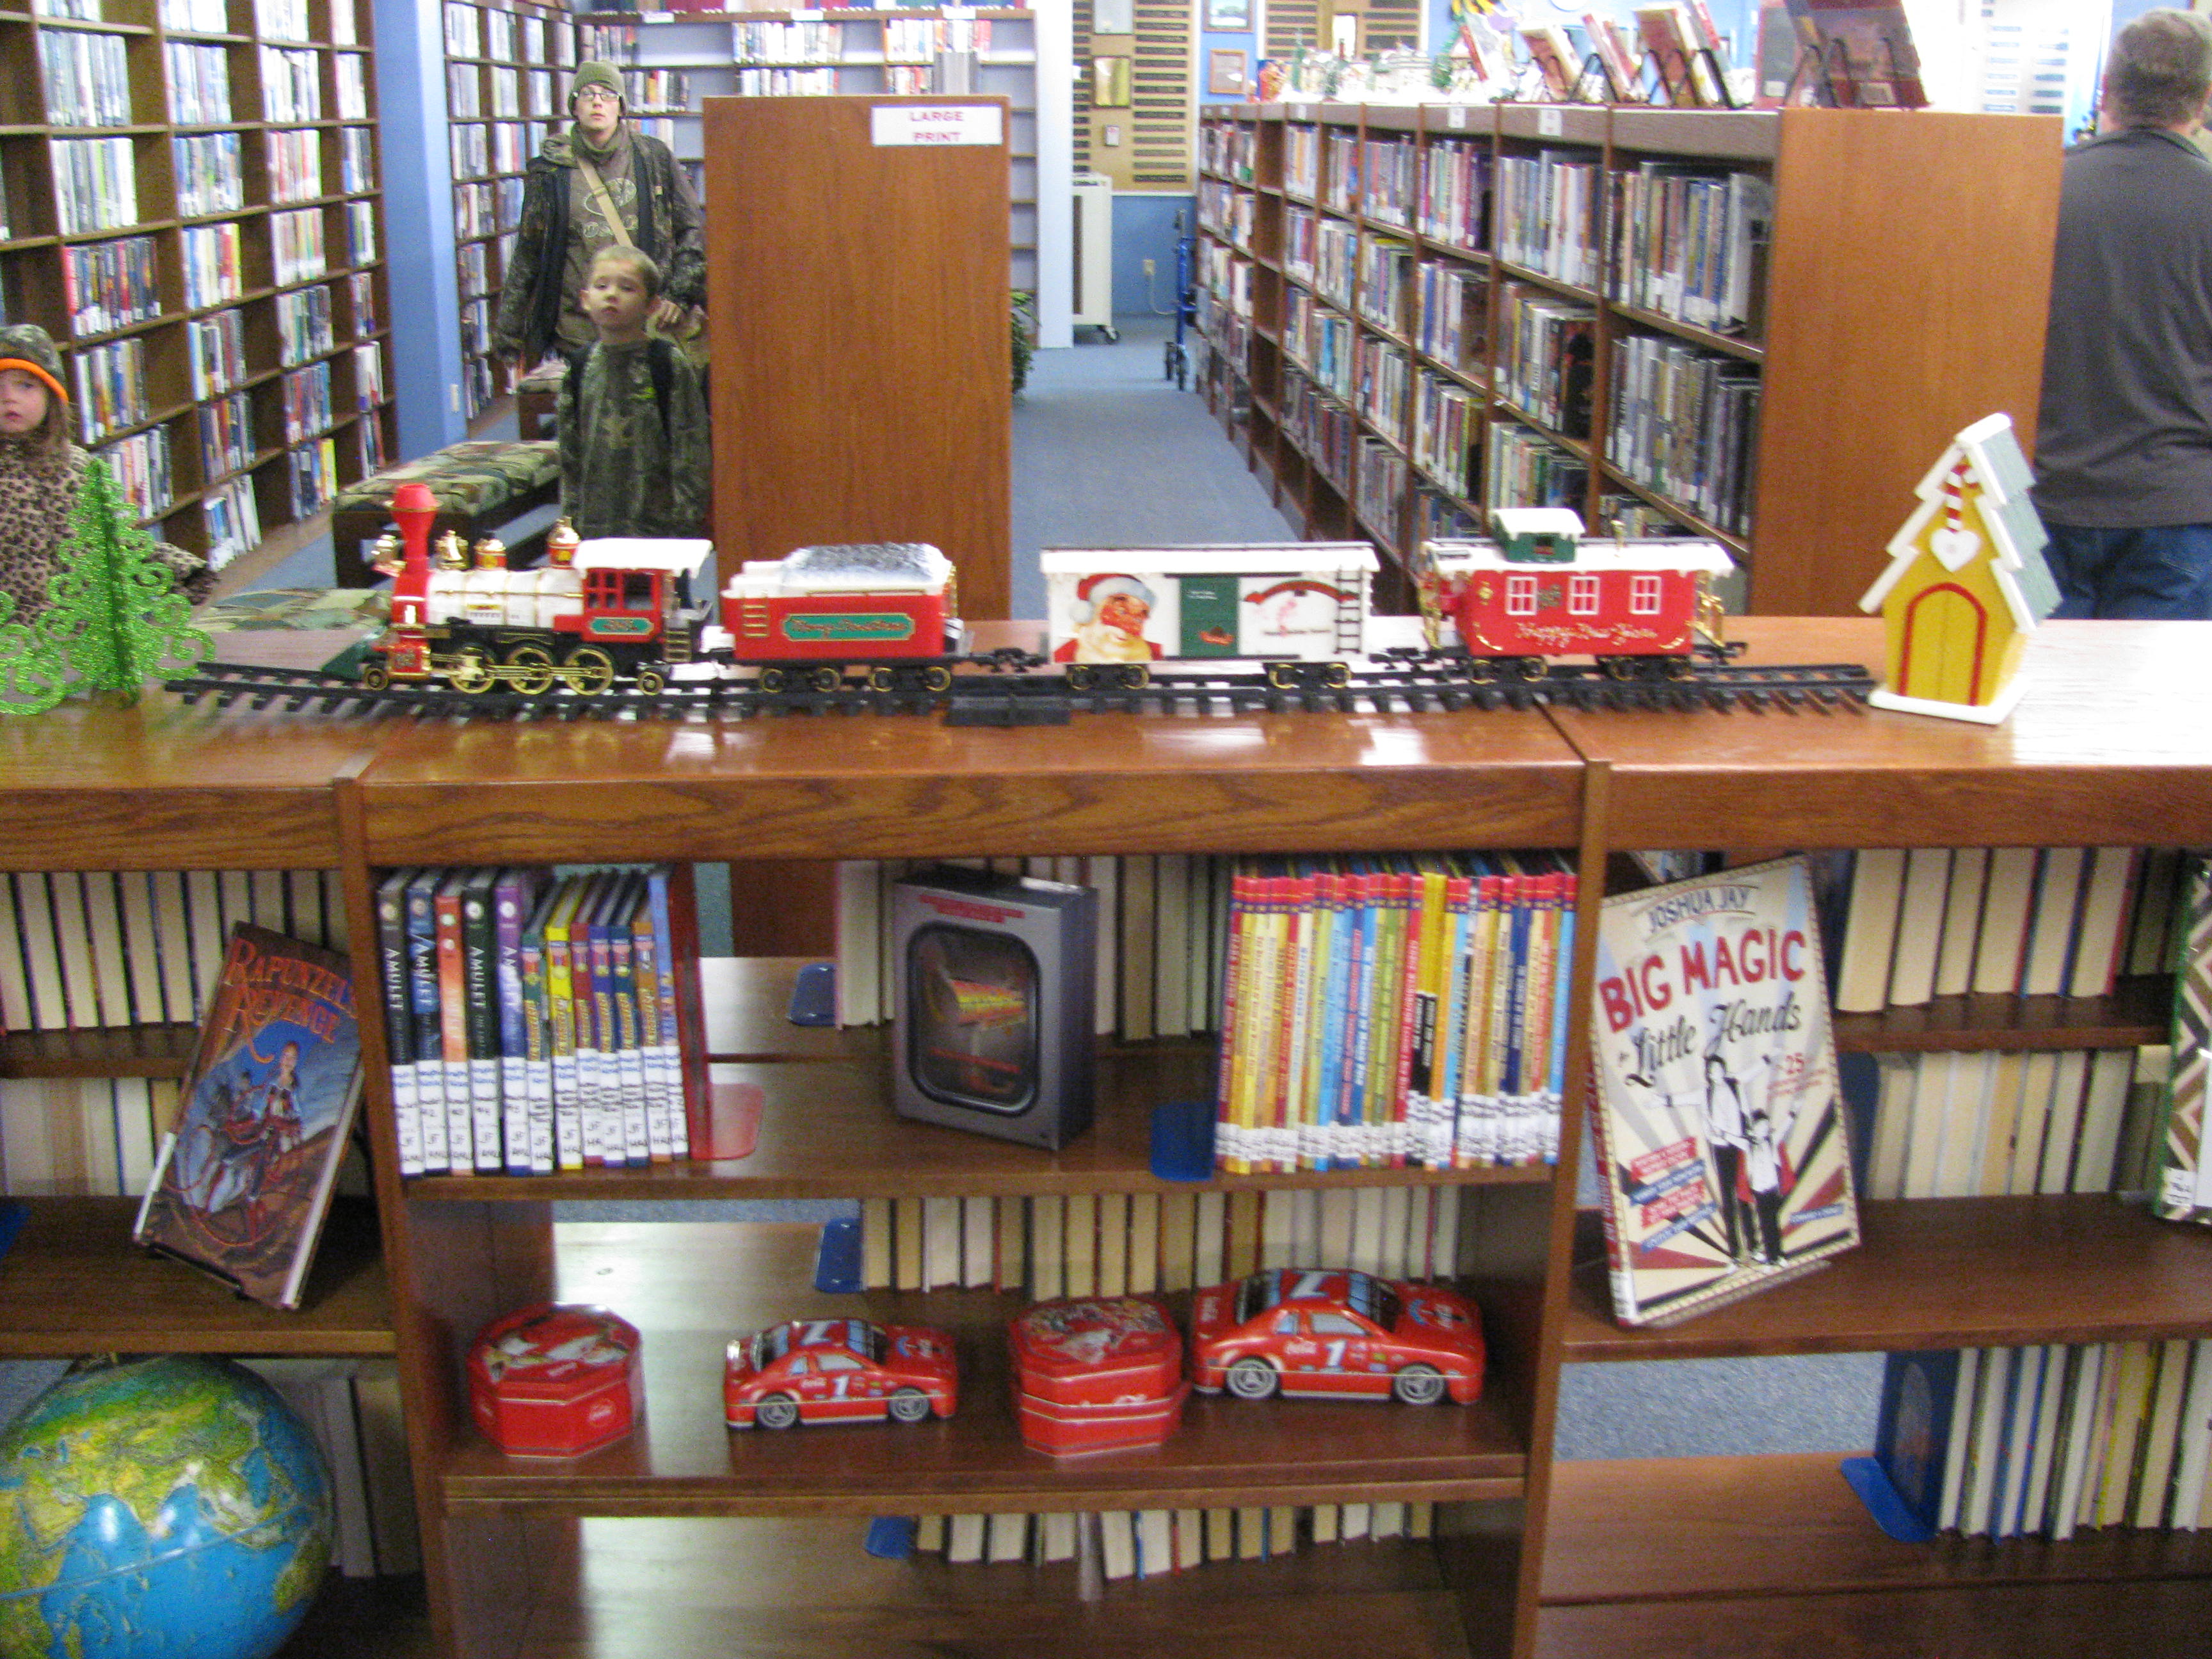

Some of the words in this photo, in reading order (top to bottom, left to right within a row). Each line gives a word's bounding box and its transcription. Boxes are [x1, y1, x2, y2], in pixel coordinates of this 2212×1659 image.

[909, 111, 964, 122] LARGE
[913, 132, 963, 143] PRINT
[1649, 888, 1716, 933] JOSHUA
[1720, 886, 1752, 910] JAY
[385, 947, 404, 1011] AMULET
[415, 943, 438, 1004] AMULET
[469, 946, 486, 1008] AMULET
[1599, 954, 1672, 1034] BIG
[1679, 928, 1807, 995] MAGIC
[1624, 1014, 1697, 1089] Little
[1705, 990, 1802, 1048] Hands
[1320, 1340, 1347, 1373] 1
[830, 1374, 850, 1402] 1
